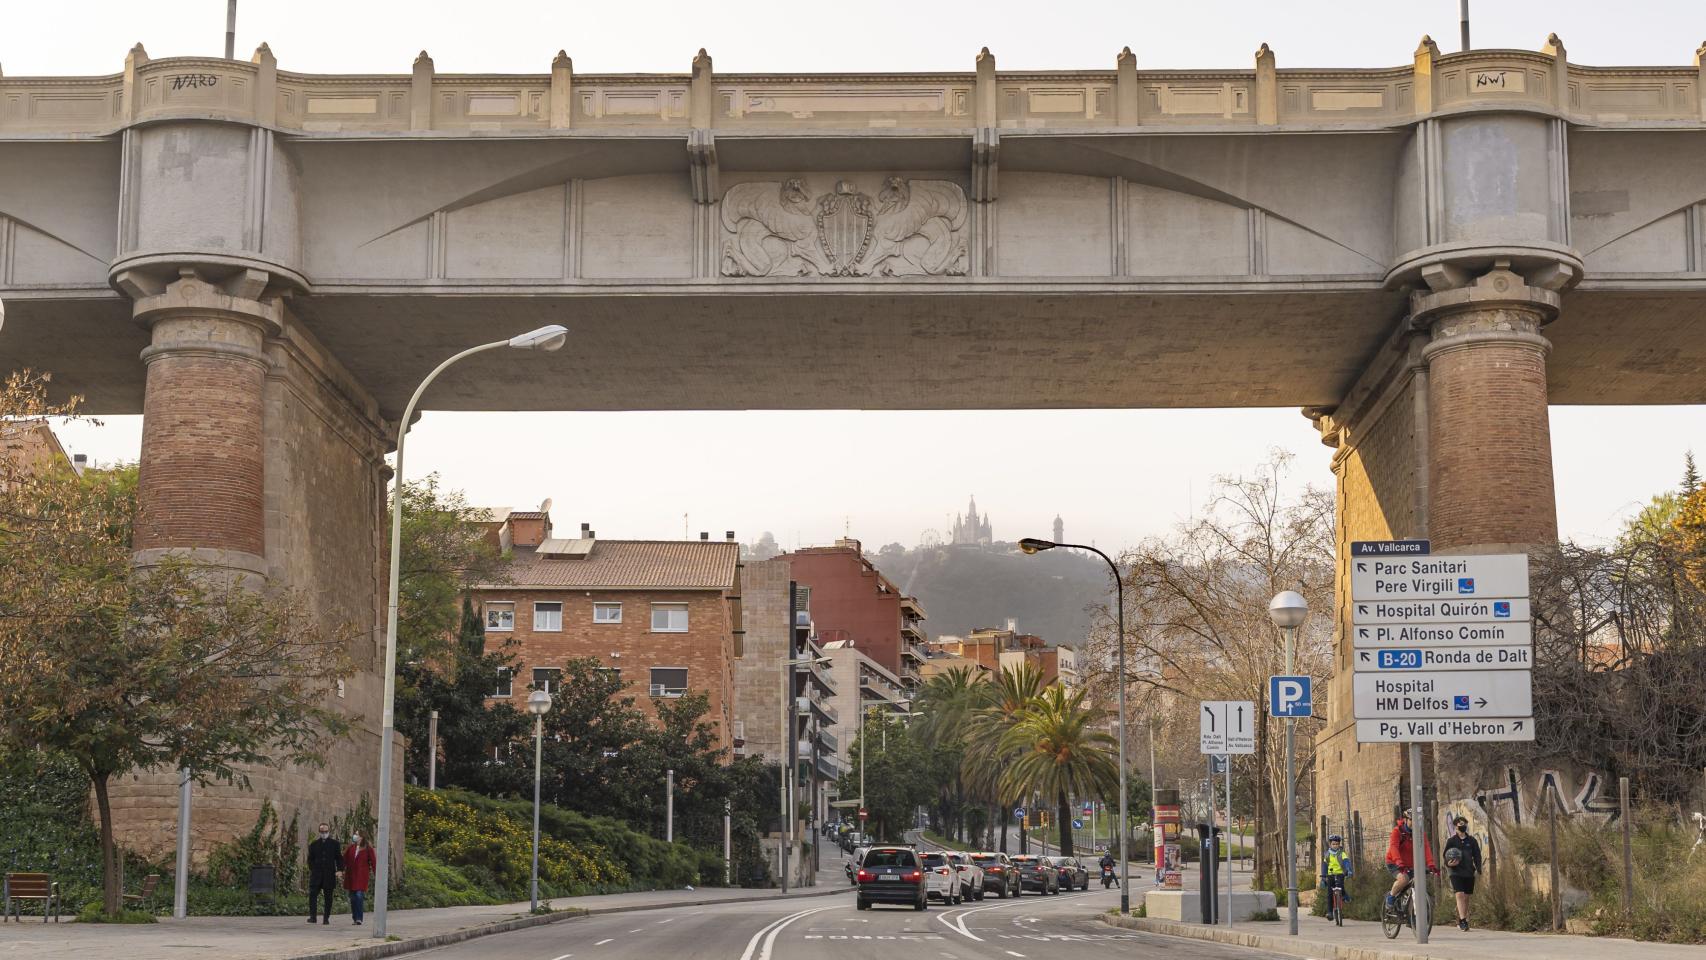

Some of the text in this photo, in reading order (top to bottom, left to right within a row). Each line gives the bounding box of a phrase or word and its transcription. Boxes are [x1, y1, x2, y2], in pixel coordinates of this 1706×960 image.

[1361, 543, 1421, 553] Av. Vallcarca
[1375, 560, 1467, 575] Parc Sanitari
[1375, 578, 1453, 595] Pere Virgili
[1376, 602, 1488, 619] Hospital Quirón
[1377, 626, 1505, 641] Pl. Alfonso Comín
[1383, 649, 1528, 666] B-20 Ronda de Dalt
[1376, 679, 1434, 695] Hospital
[1278, 680, 1303, 713] P
[1376, 697, 1449, 711] HM Delfos
[1380, 720, 1505, 739] Pg. Vall d'Hebron
